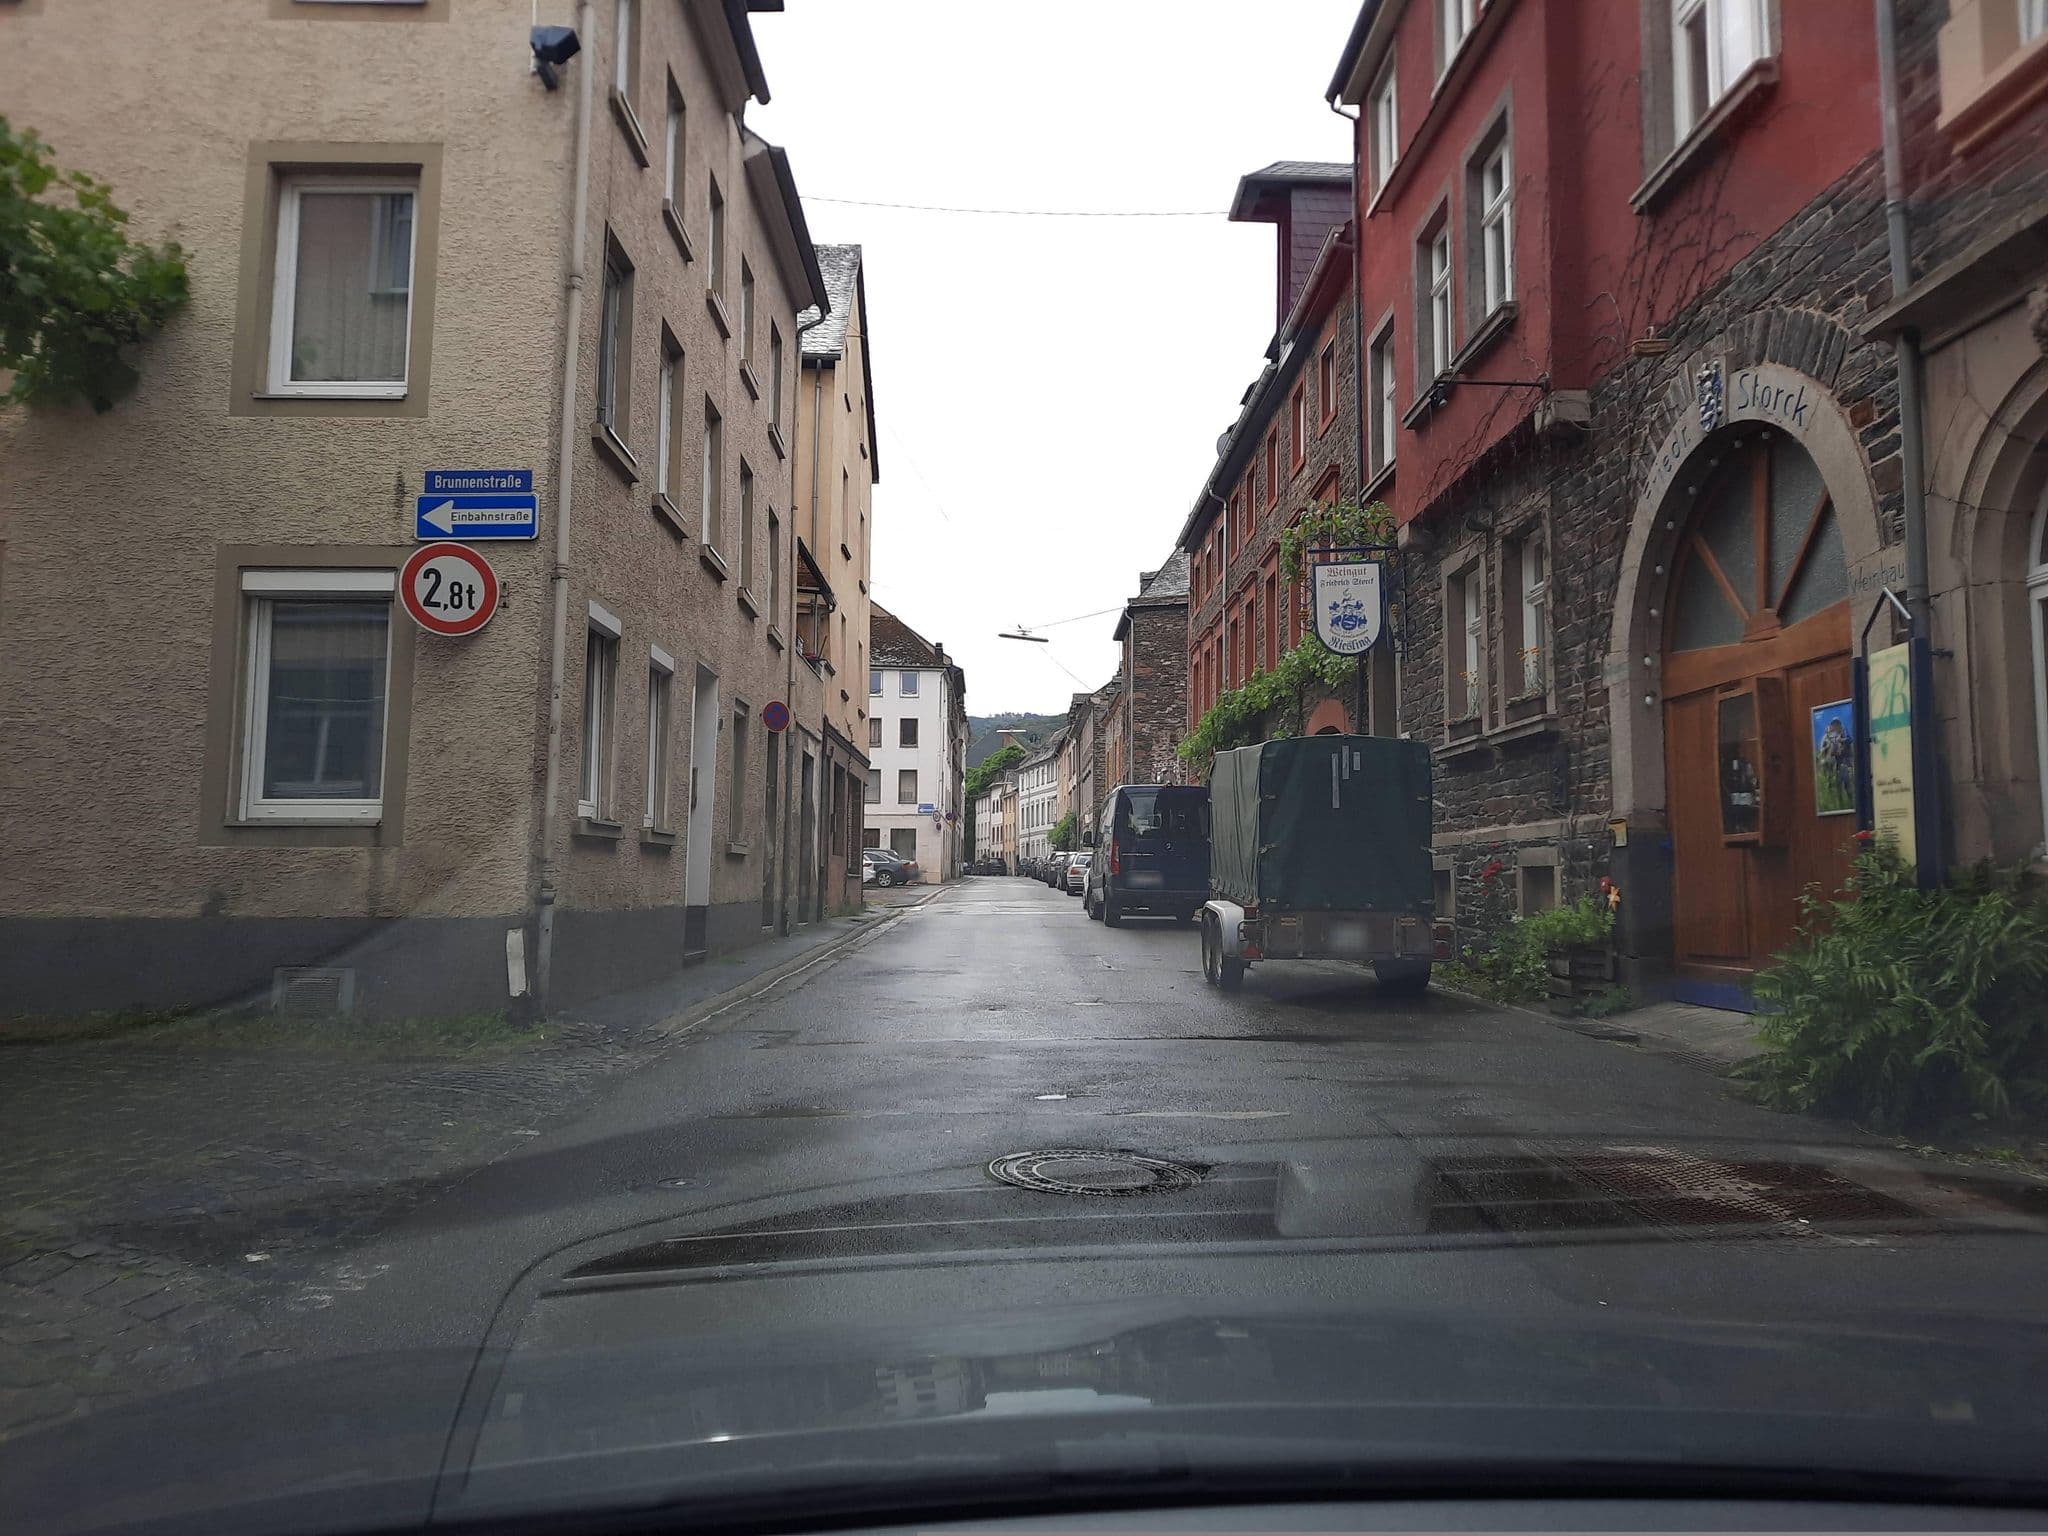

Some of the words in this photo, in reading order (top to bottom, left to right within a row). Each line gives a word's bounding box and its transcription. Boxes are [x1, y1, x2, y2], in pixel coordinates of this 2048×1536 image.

[1737, 372, 1809, 427] Storck
[434, 475, 522, 489] Brunnenstraße
[450, 511, 529, 522] Einbahnstraße
[1327, 567, 1367, 578] Weingut
[422, 567, 476, 611] 2,8t
[1329, 635, 1371, 651] Riesling
